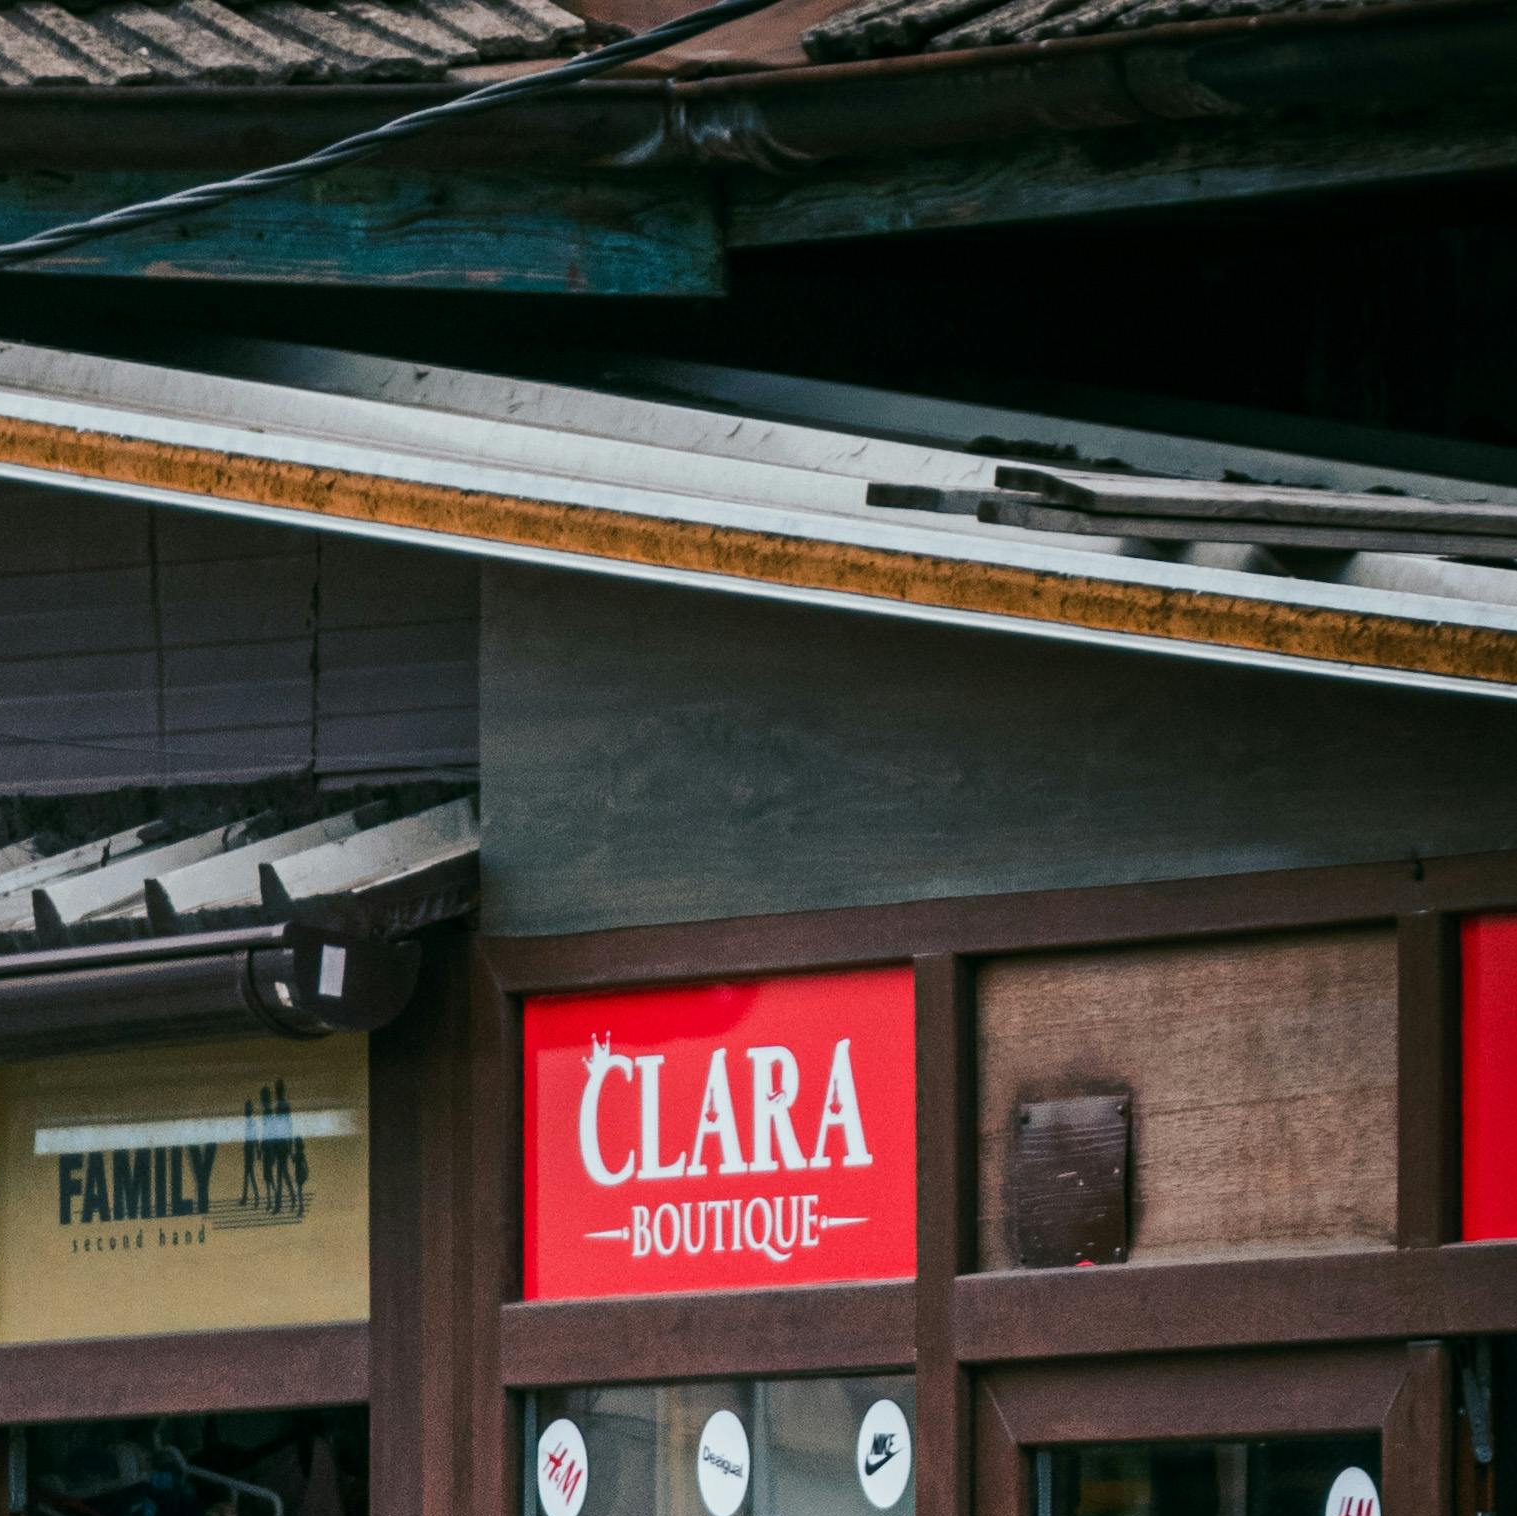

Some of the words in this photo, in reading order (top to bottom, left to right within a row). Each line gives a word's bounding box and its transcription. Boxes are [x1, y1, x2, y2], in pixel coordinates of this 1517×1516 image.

[579, 1036, 873, 1186] CLARA
[59, 1142, 218, 1225] FAMILY
[71, 1228, 144, 1254] second
[157, 1224, 207, 1247] hand
[630, 1194, 820, 1262] BOUTIQUE
[872, 1432, 897, 1457] NIKE
